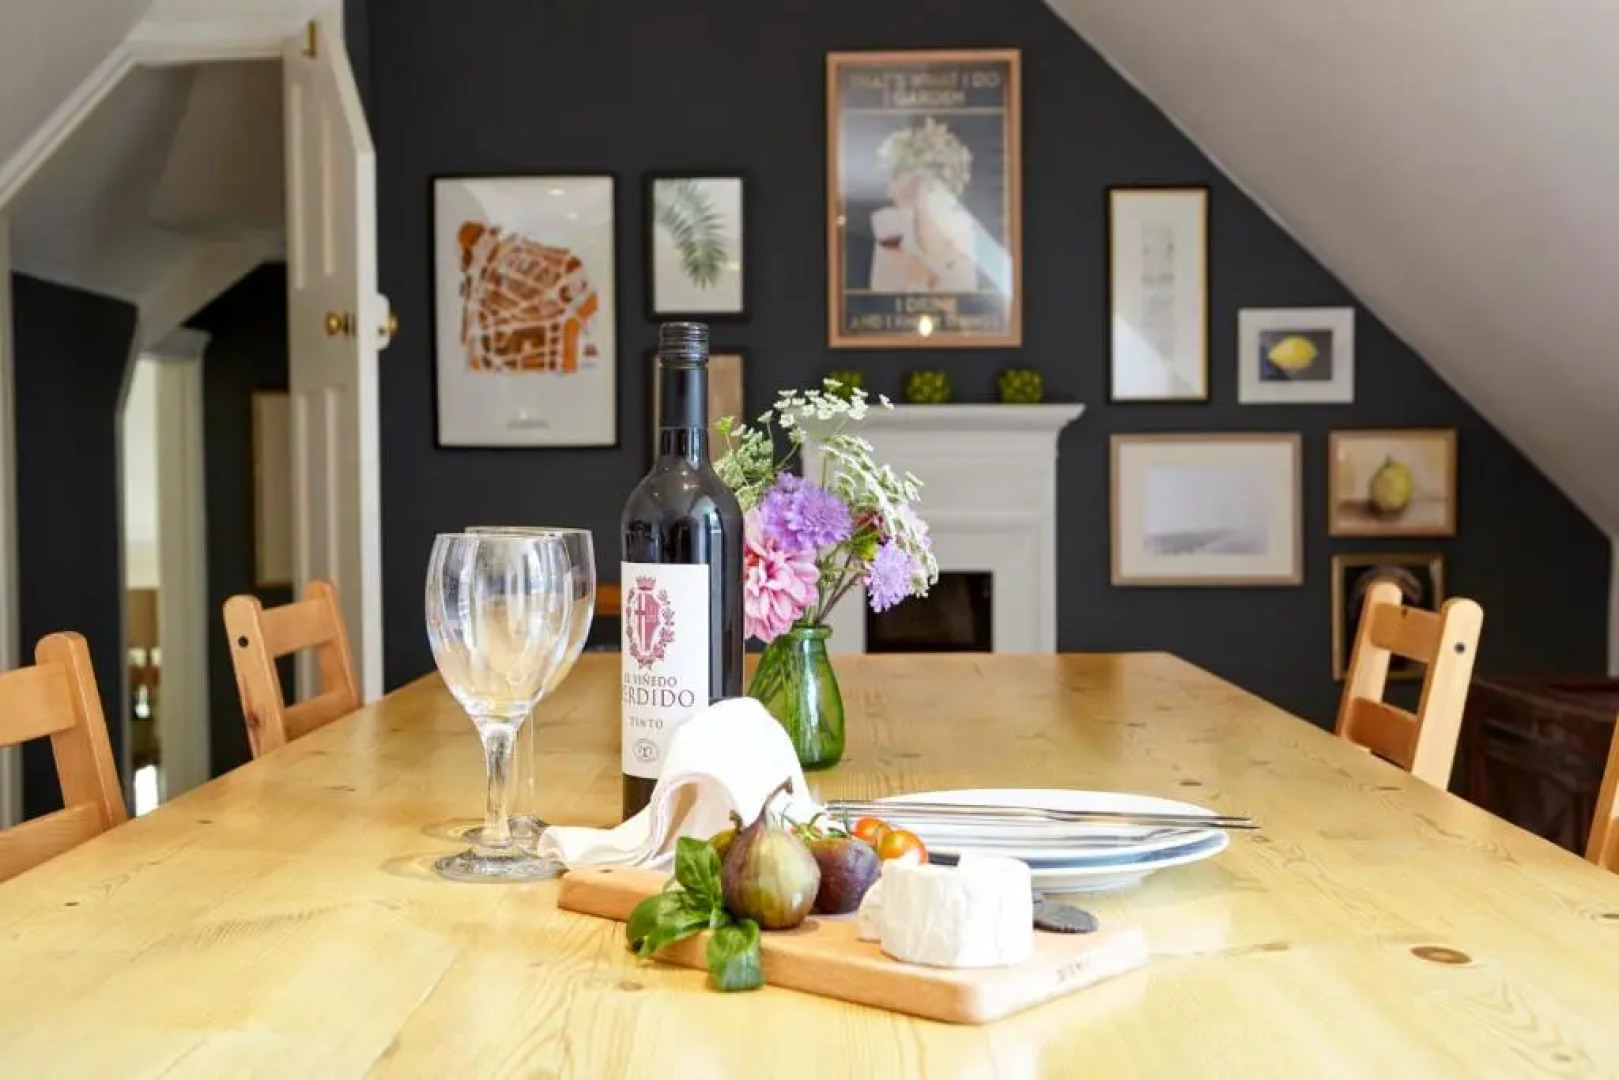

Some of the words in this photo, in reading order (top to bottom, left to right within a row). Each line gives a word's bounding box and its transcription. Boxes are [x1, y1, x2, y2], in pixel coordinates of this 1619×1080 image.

[632, 673, 677, 687] VIÑEDO
[622, 684, 695, 708] ERDIDO
[630, 715, 663, 729] TINTO
